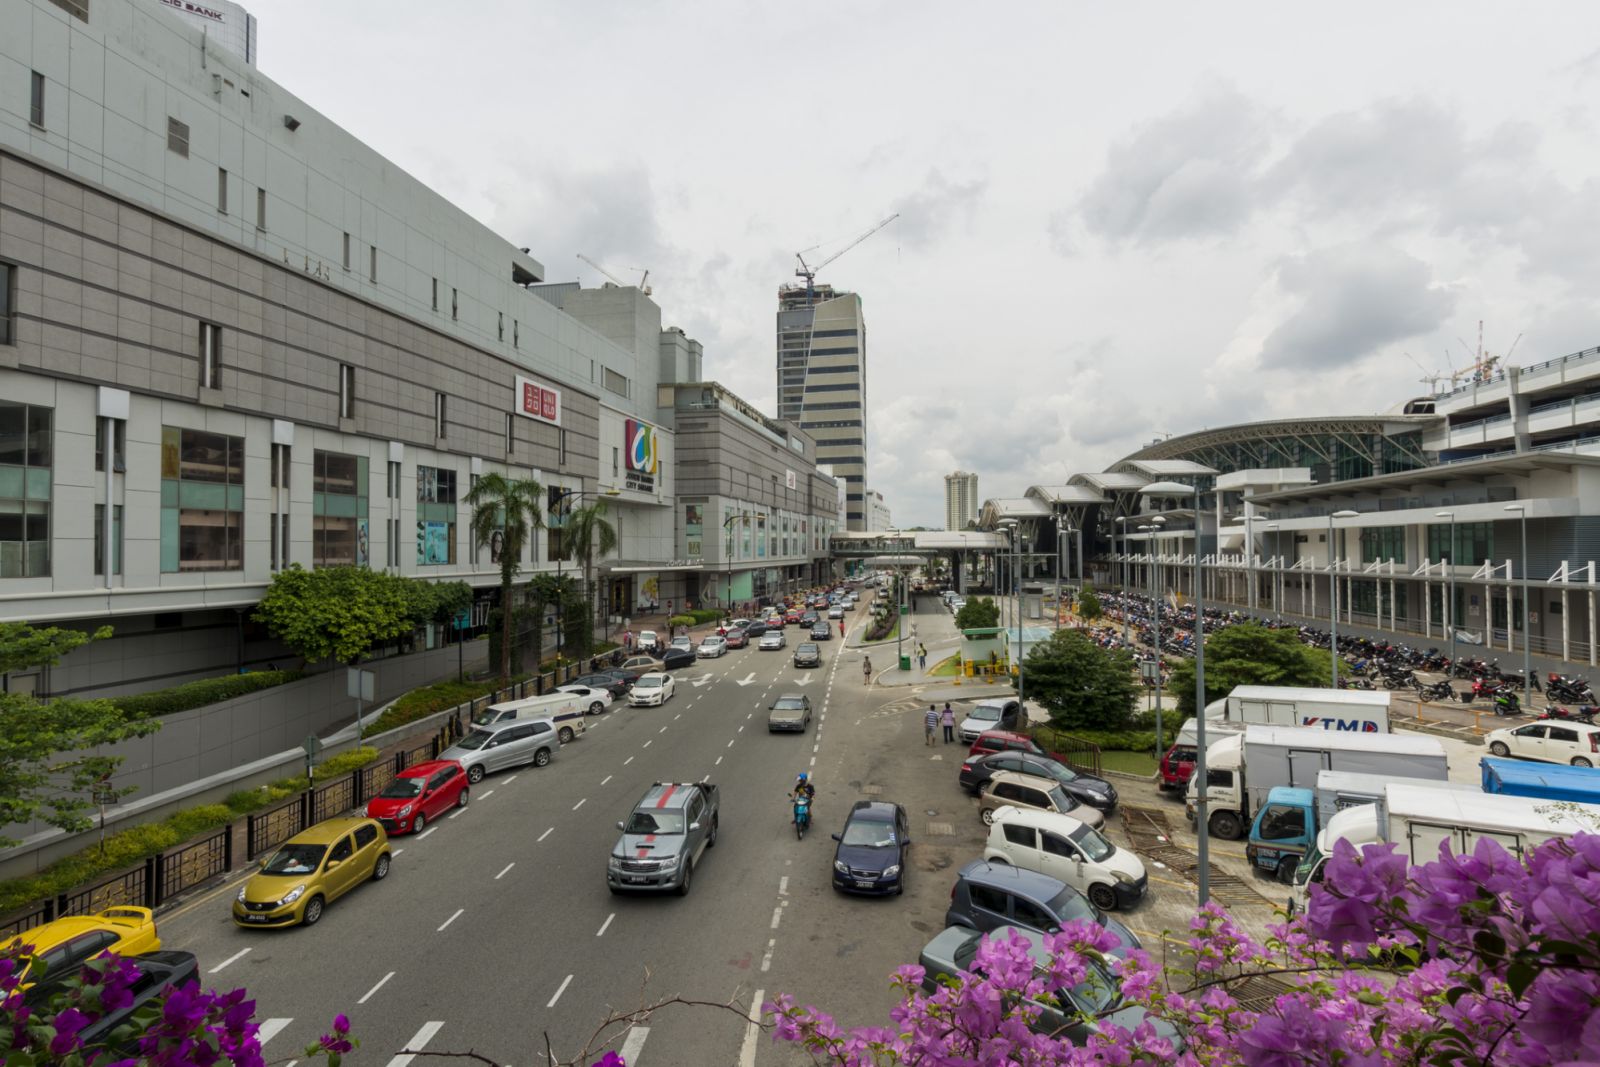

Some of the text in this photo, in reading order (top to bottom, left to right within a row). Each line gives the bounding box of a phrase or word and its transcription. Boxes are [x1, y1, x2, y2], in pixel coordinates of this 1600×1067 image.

[185, 4, 223, 20] BANK
[625, 481, 654, 493] CITY SQUARE
